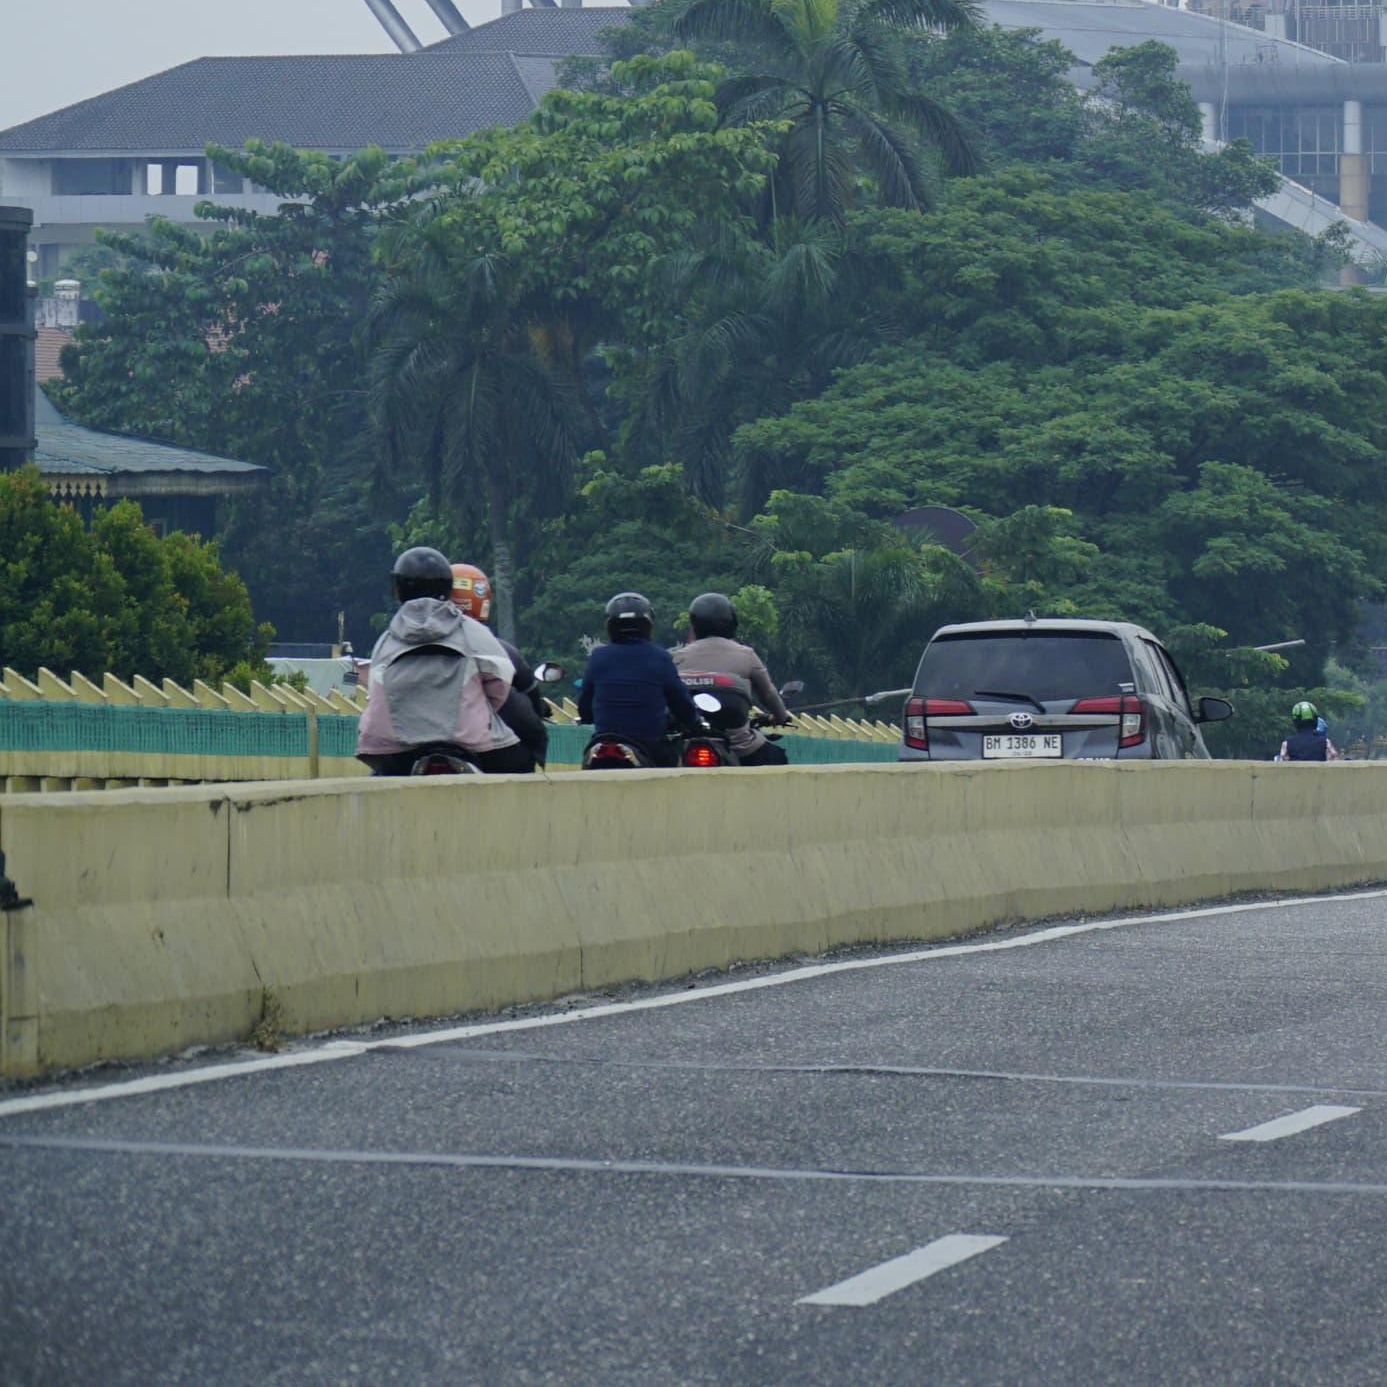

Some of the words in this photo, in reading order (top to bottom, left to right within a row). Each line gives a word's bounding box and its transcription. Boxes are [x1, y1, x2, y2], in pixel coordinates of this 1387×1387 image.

[986, 737, 1001, 750] BM
[1007, 737, 1036, 750] 1386
[1043, 736, 1058, 749] NE
